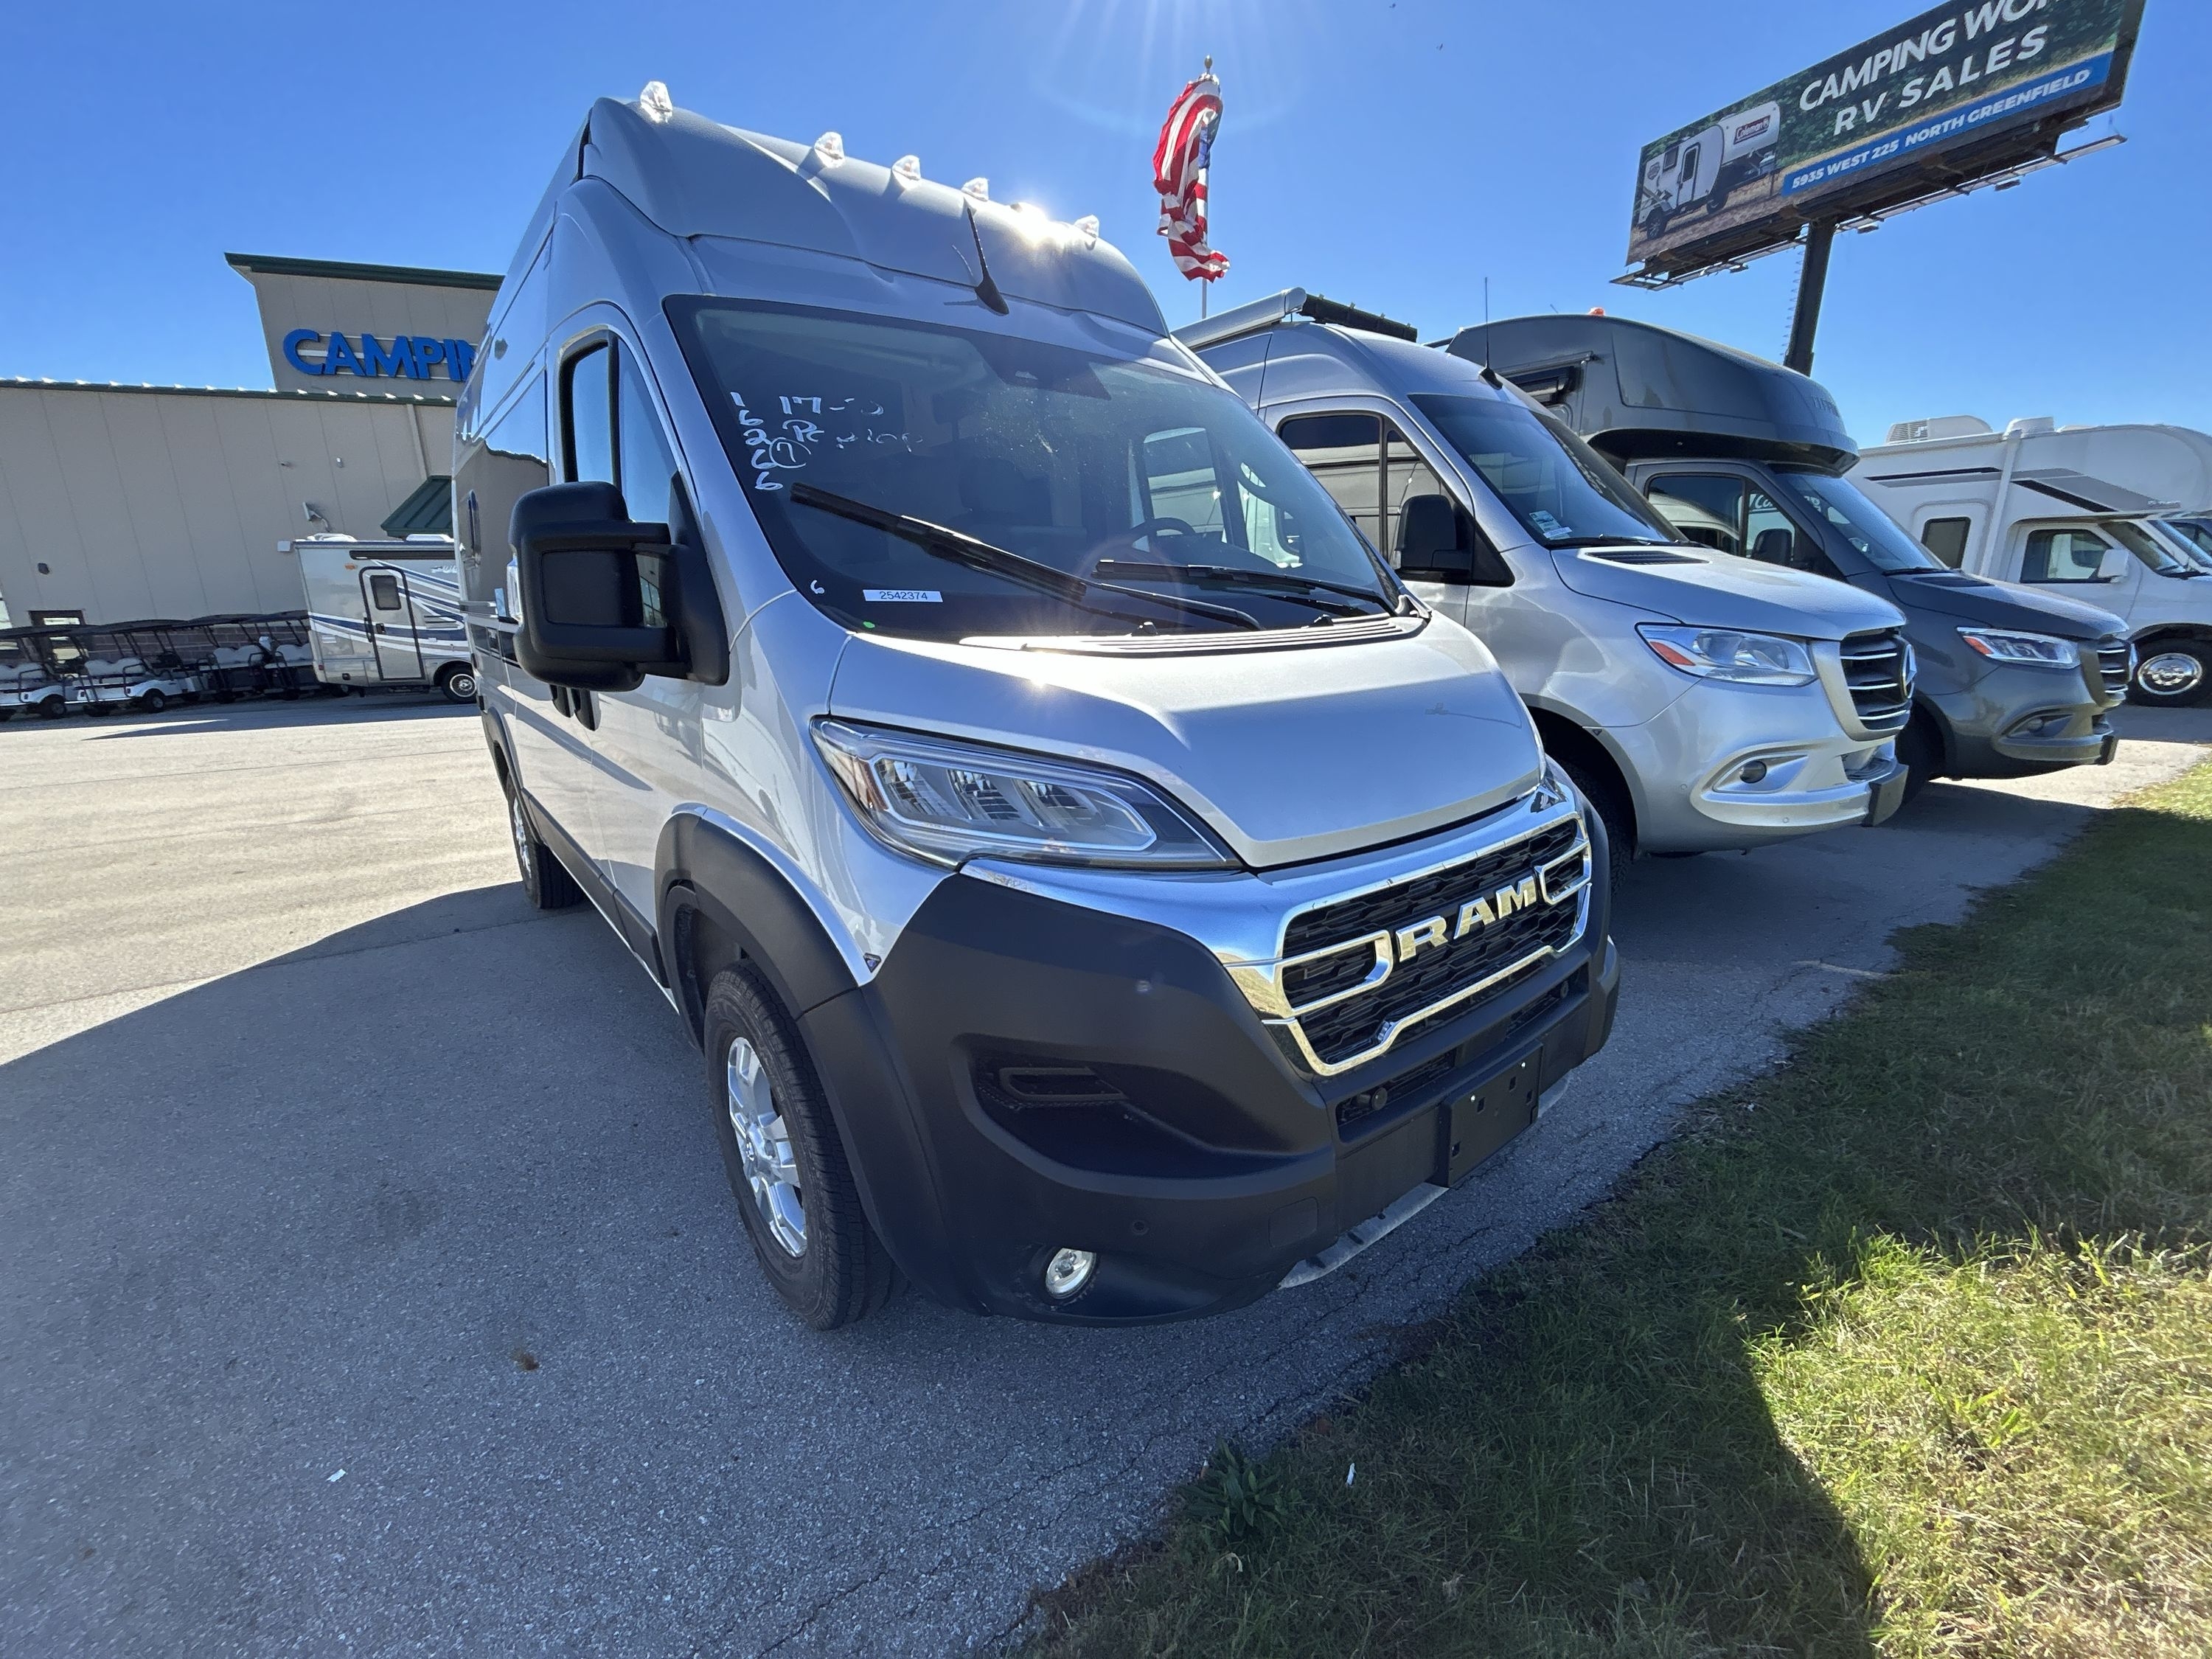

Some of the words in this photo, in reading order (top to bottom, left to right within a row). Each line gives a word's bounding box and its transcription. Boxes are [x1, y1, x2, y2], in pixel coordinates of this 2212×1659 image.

[1799, 18, 1956, 111] CAMPING
[1964, 0, 2047, 40] WO
[1834, 91, 1888, 136] RV
[1898, 25, 2048, 109] SALES
[1792, 167, 1825, 189] 5935
[1826, 150, 1871, 175] WEST
[1871, 139, 1899, 160] 225
[1905, 114, 1965, 147] NORTH
[1967, 69, 2090, 123] GREENFIELD
[880, 591, 928, 599] 2542374
[1396, 876, 1537, 962] RAM
